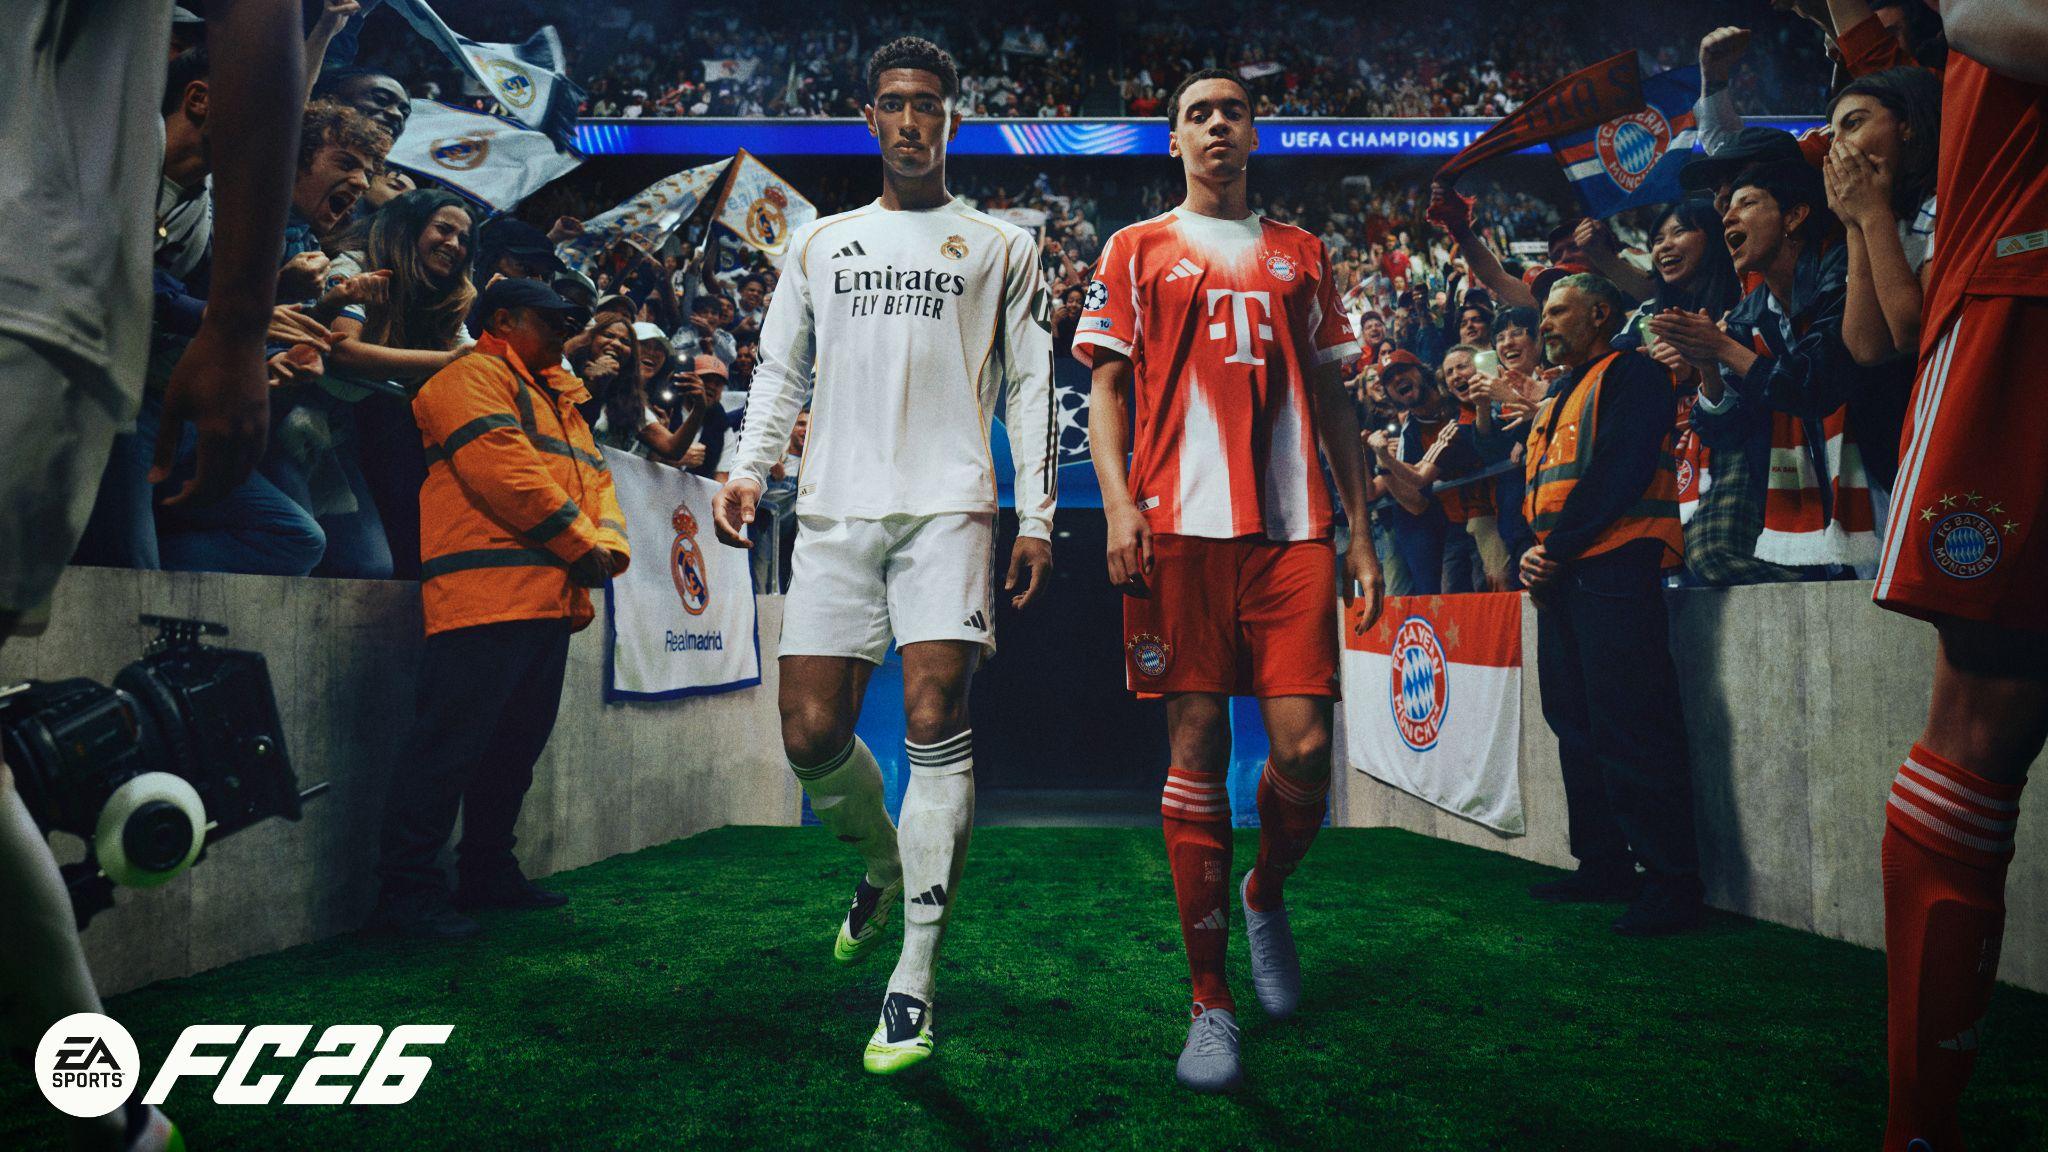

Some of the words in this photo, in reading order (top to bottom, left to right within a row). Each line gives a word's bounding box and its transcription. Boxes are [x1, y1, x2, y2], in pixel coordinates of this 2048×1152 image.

[1281, 131, 1332, 148] UEFA
[1337, 131, 1460, 148] CHAMPIONS
[834, 265, 965, 296] Emirates
[851, 294, 879, 317] FLY
[883, 293, 944, 320] BETTER
[1206, 288, 1273, 366] T
[1937, 522, 1952, 537] FC
[1955, 516, 1997, 545] BAYERN
[1393, 643, 1405, 672] FC
